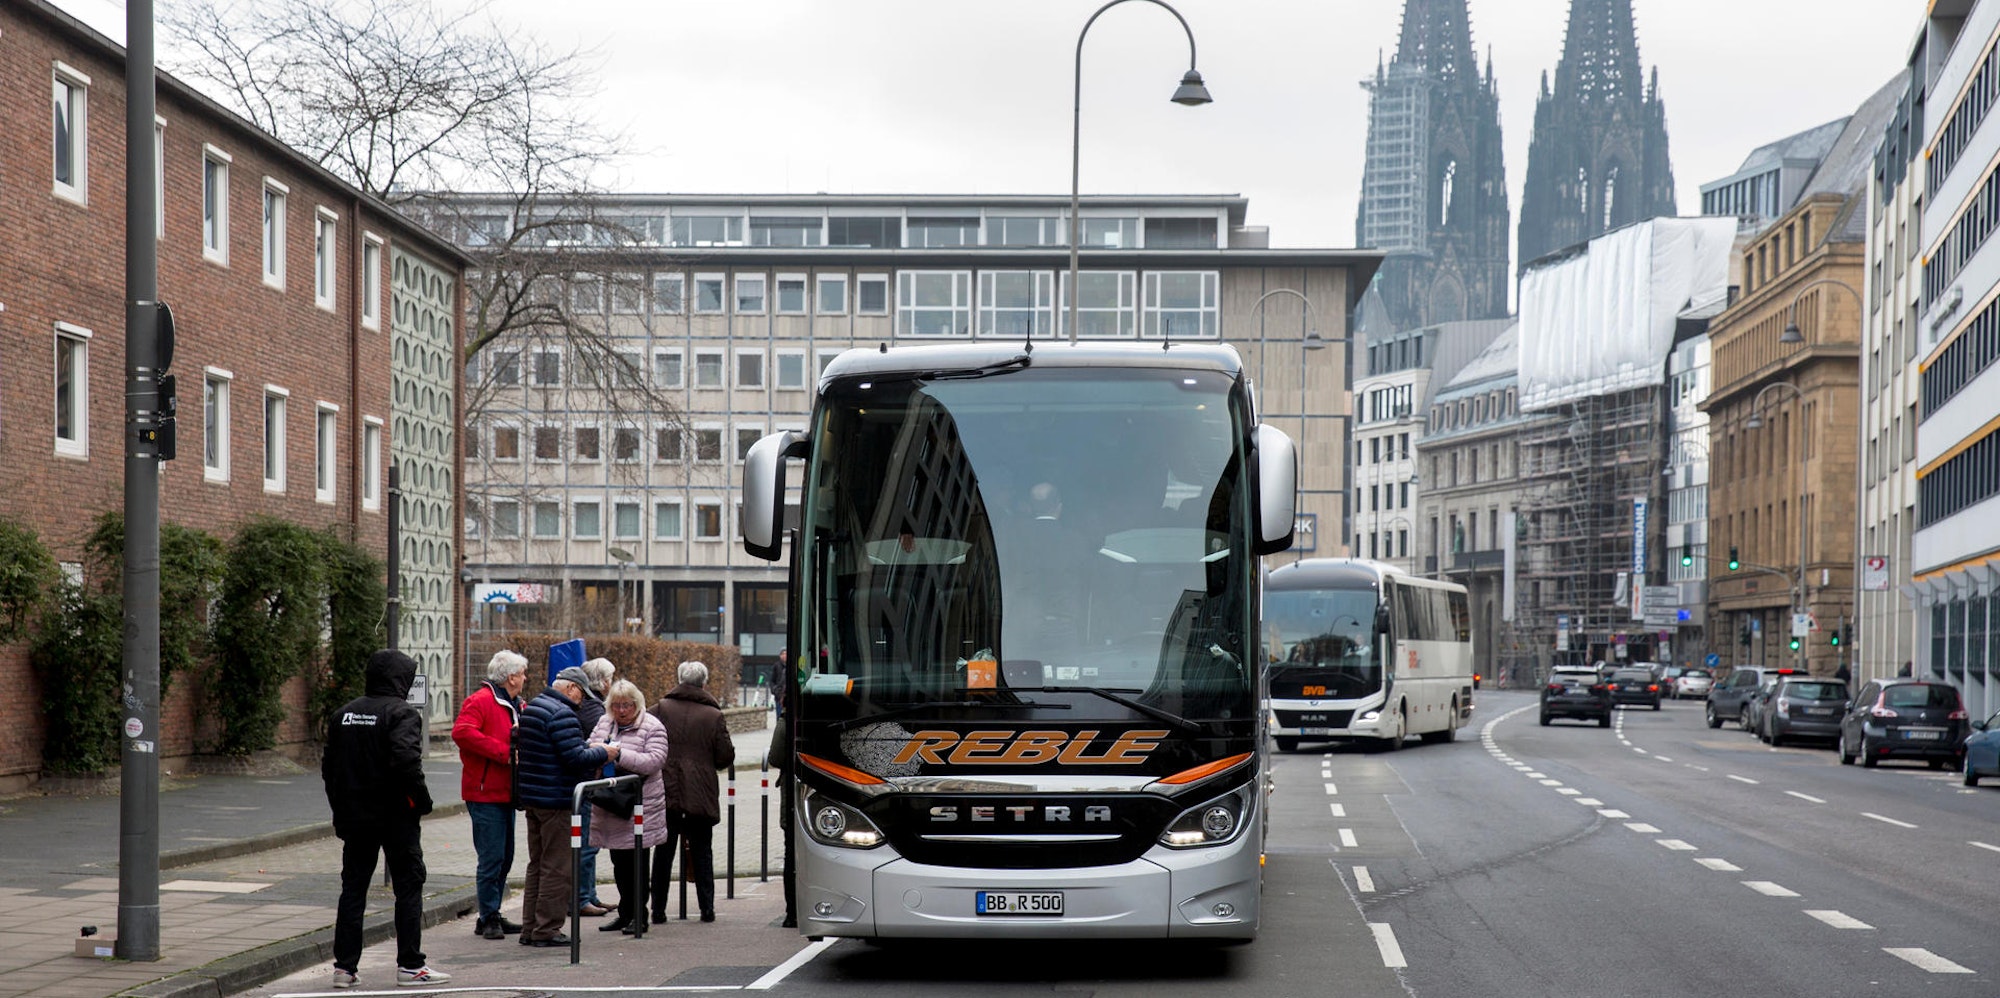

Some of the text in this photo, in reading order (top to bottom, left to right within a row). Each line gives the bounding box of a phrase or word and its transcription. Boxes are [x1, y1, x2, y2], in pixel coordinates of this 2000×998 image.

[1635, 503, 1645, 573] ODENDAHL
[1302, 685, 1326, 696] BVB
[891, 729, 1171, 765] REBLE
[930, 805, 1112, 822] SETRA
[987, 895, 1061, 910] BB R 500
